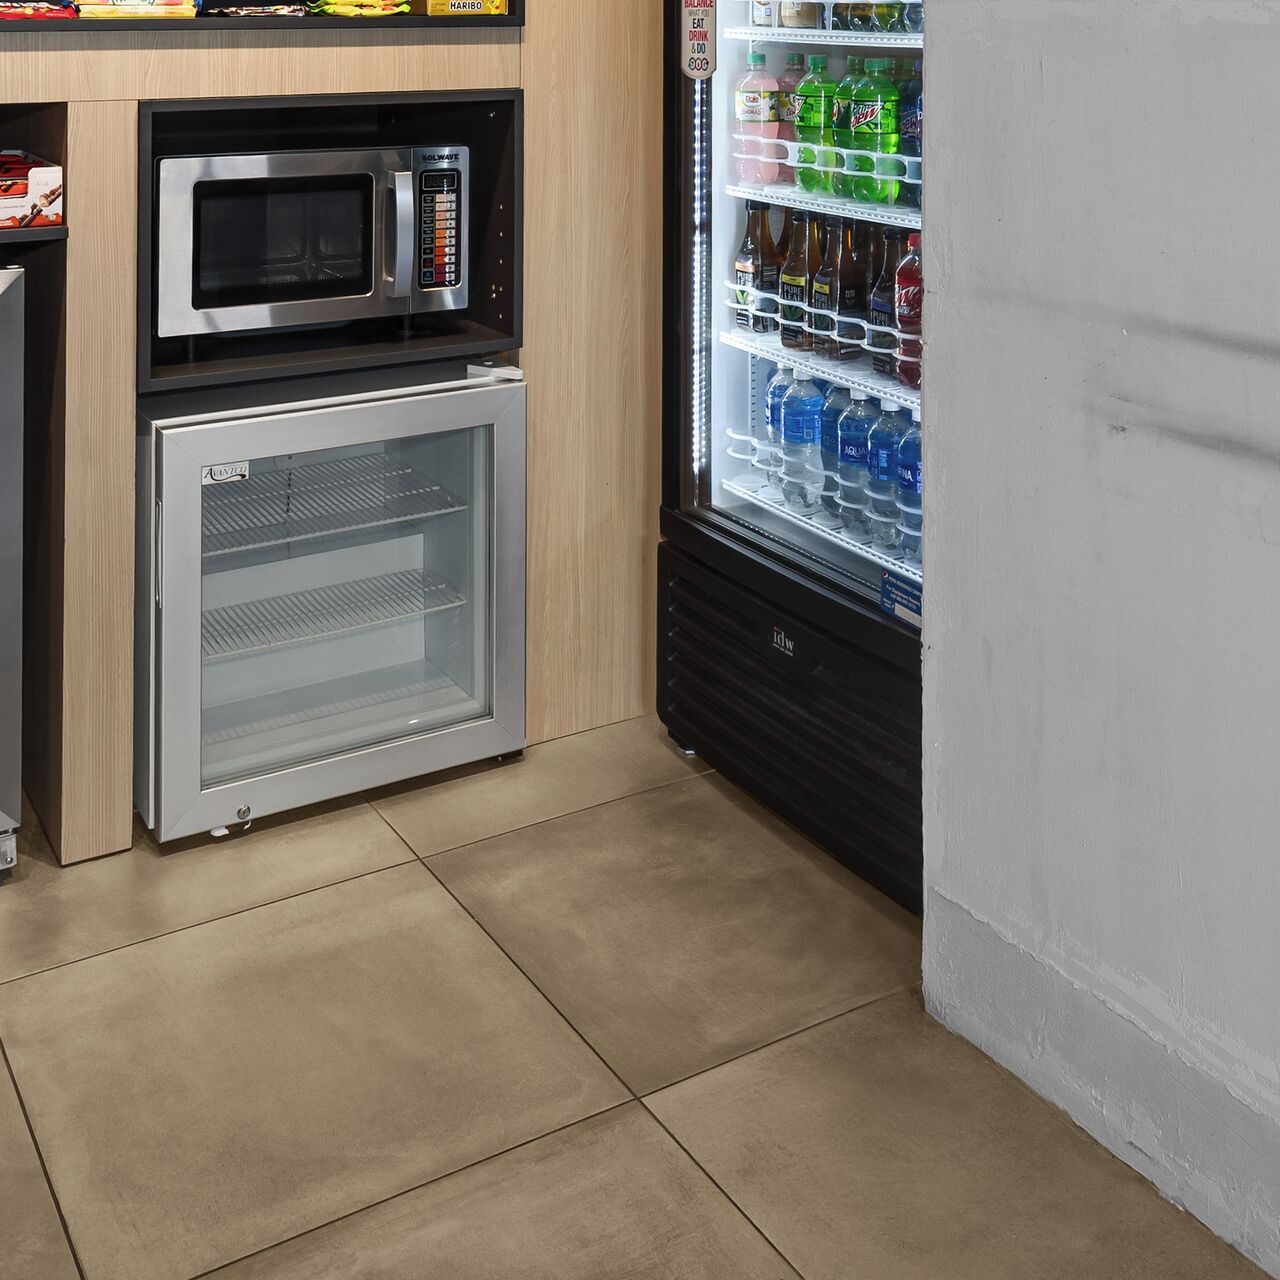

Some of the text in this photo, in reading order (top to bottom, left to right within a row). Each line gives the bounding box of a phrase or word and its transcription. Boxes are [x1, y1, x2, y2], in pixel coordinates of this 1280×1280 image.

[449, 1, 483, 11] HARIBO
[688, 9, 709, 17] WHAT YOU
[692, 18, 704, 29] EAT
[689, 31, 708, 42] DRINK
[697, 43, 705, 53] DO
[737, 271, 754, 280] PURE
[784, 284, 803, 296] PURE
[815, 293, 829, 304] PURE
[873, 311, 889, 321] PURE
[204, 465, 247, 481] AVANTCO
